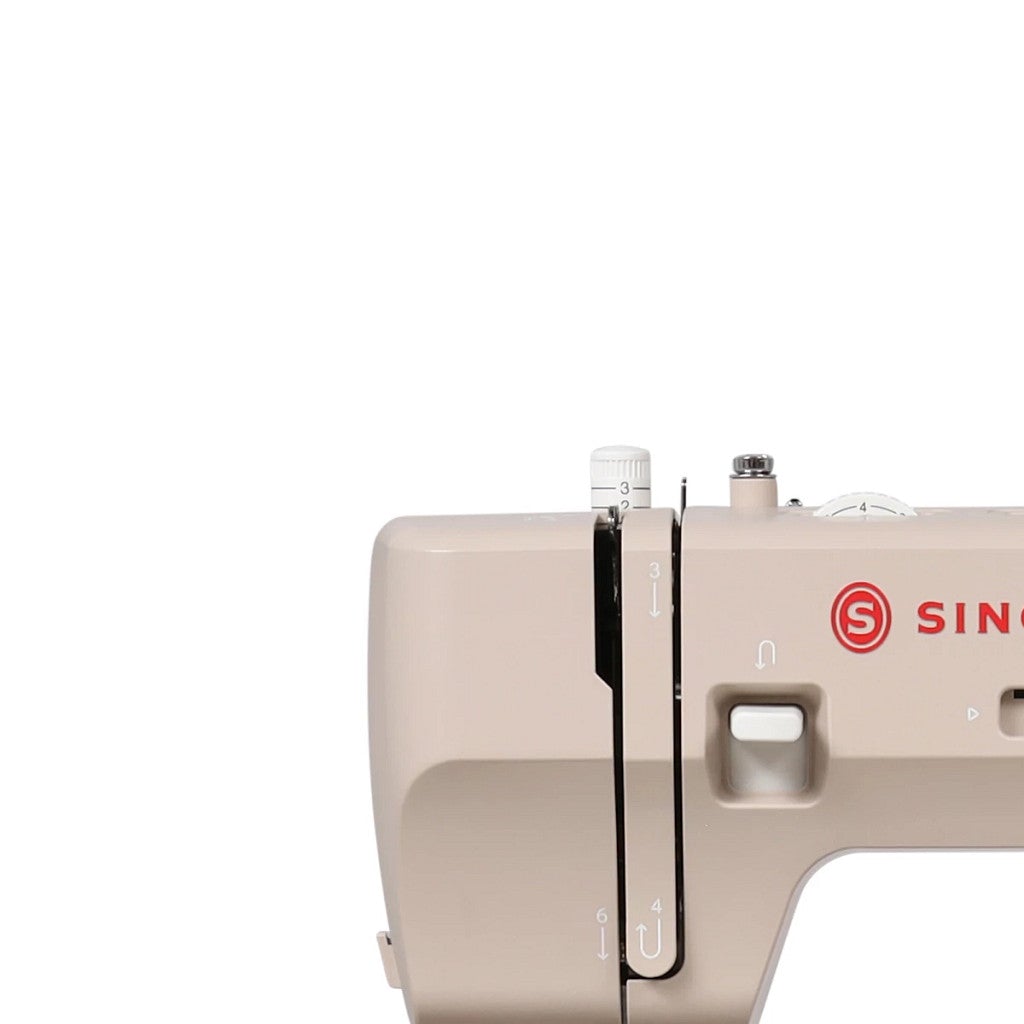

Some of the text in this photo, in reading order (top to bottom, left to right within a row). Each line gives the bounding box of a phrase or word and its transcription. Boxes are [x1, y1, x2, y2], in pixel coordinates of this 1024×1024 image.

[620, 481, 630, 495] 3
[859, 502, 867, 512] 4
[649, 561, 661, 579] 3
[651, 898, 663, 914] 4
[596, 907, 608, 924] 6
